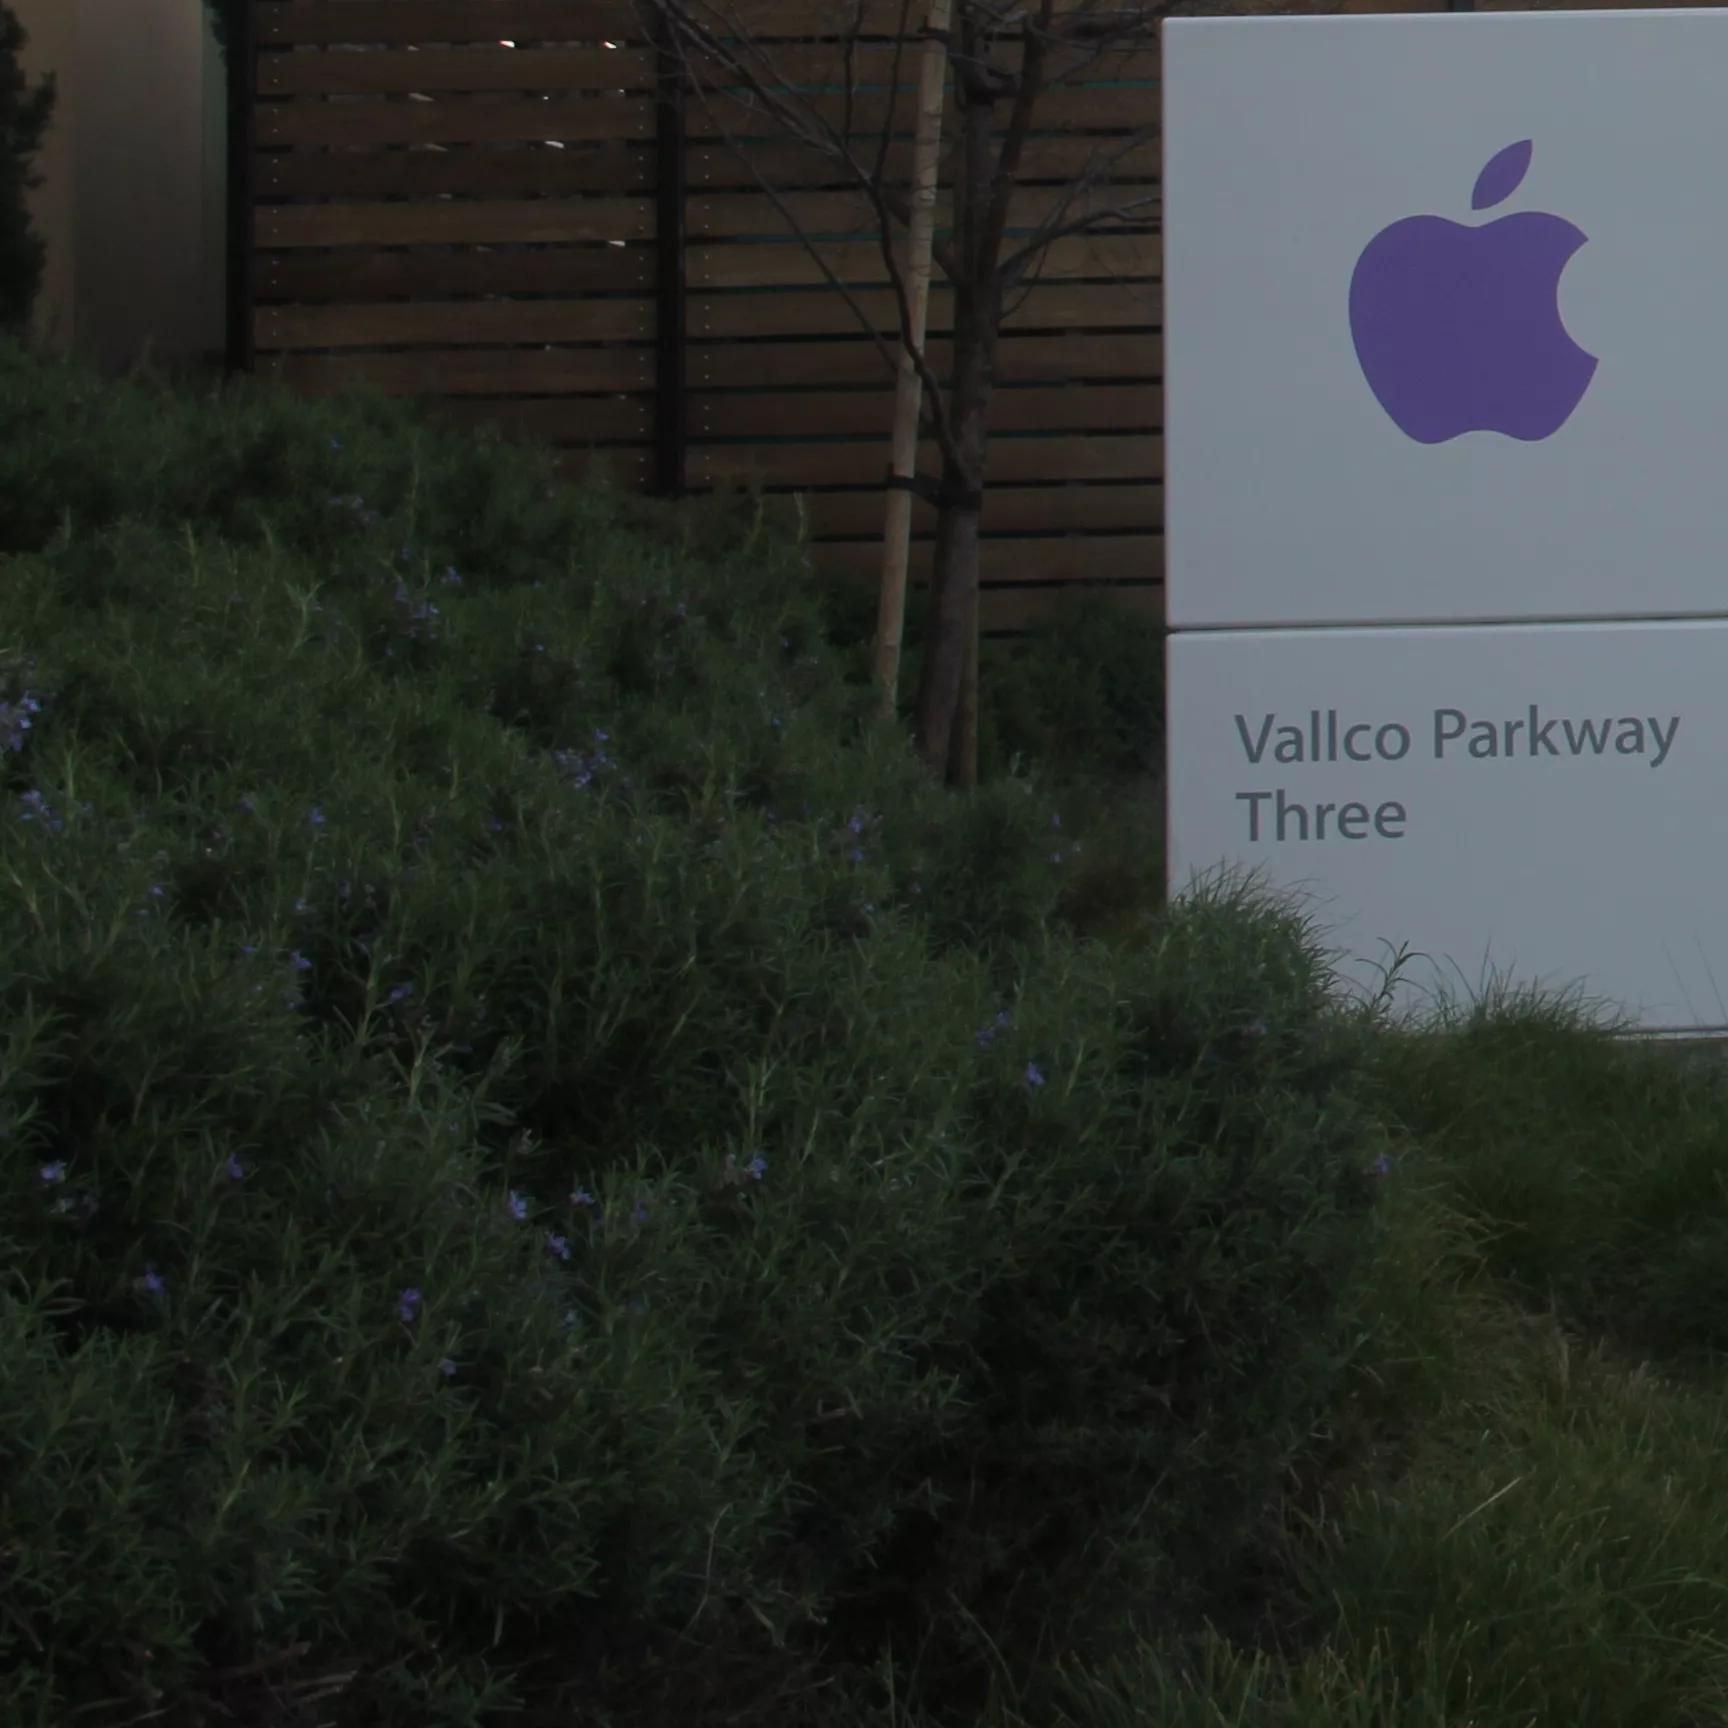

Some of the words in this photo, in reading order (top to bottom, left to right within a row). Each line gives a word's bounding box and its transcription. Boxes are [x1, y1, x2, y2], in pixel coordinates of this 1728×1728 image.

[1234, 709, 1410, 764] Vallco
[1432, 705, 1681, 768] Parkway
[1236, 789, 1407, 842] Three
